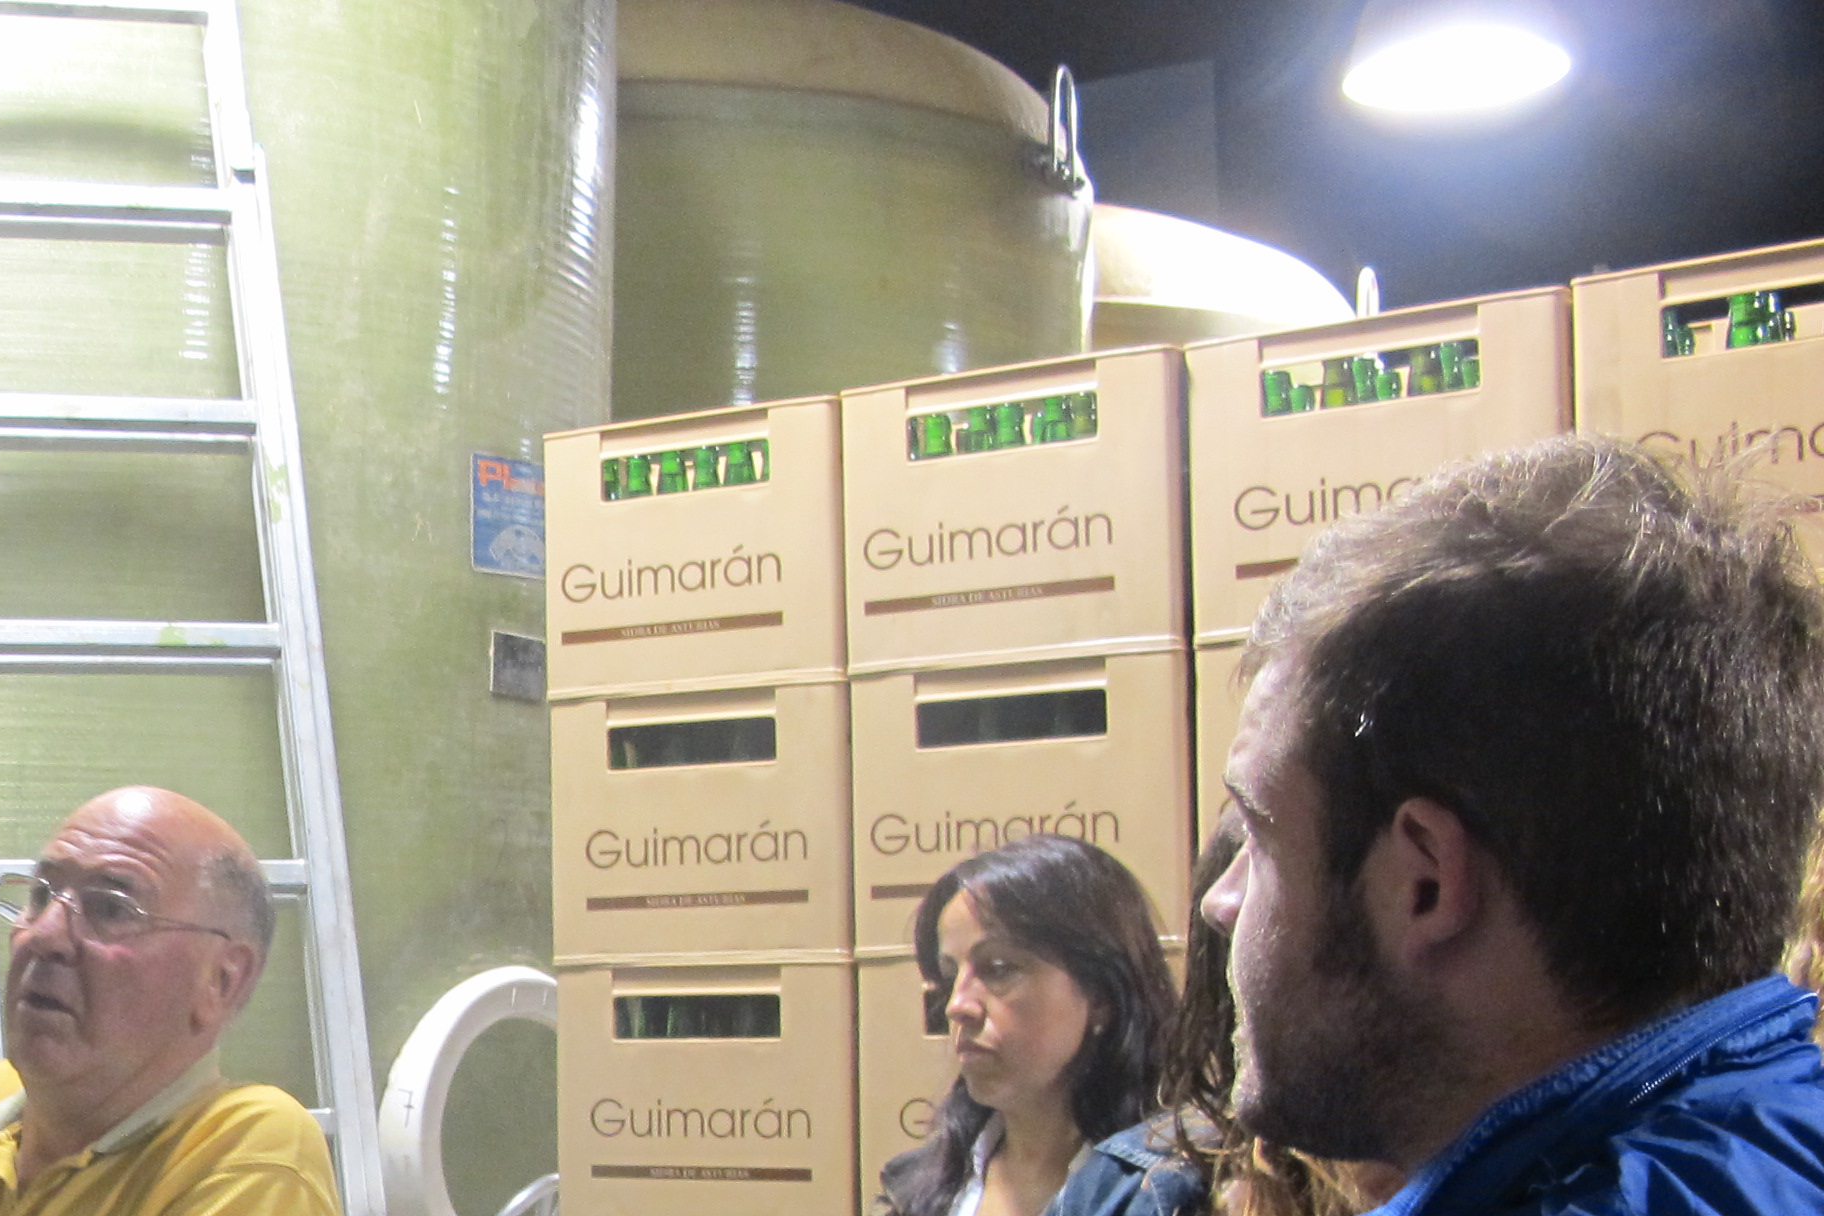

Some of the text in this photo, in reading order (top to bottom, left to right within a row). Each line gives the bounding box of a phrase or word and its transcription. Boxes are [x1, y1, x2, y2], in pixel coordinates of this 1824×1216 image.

[1234, 476, 1422, 531] Guim
[863, 505, 1113, 570] Guimarán
[561, 544, 782, 604] Guimarán
[586, 820, 808, 869] Guimarán
[590, 1097, 812, 1139] Guimarán
